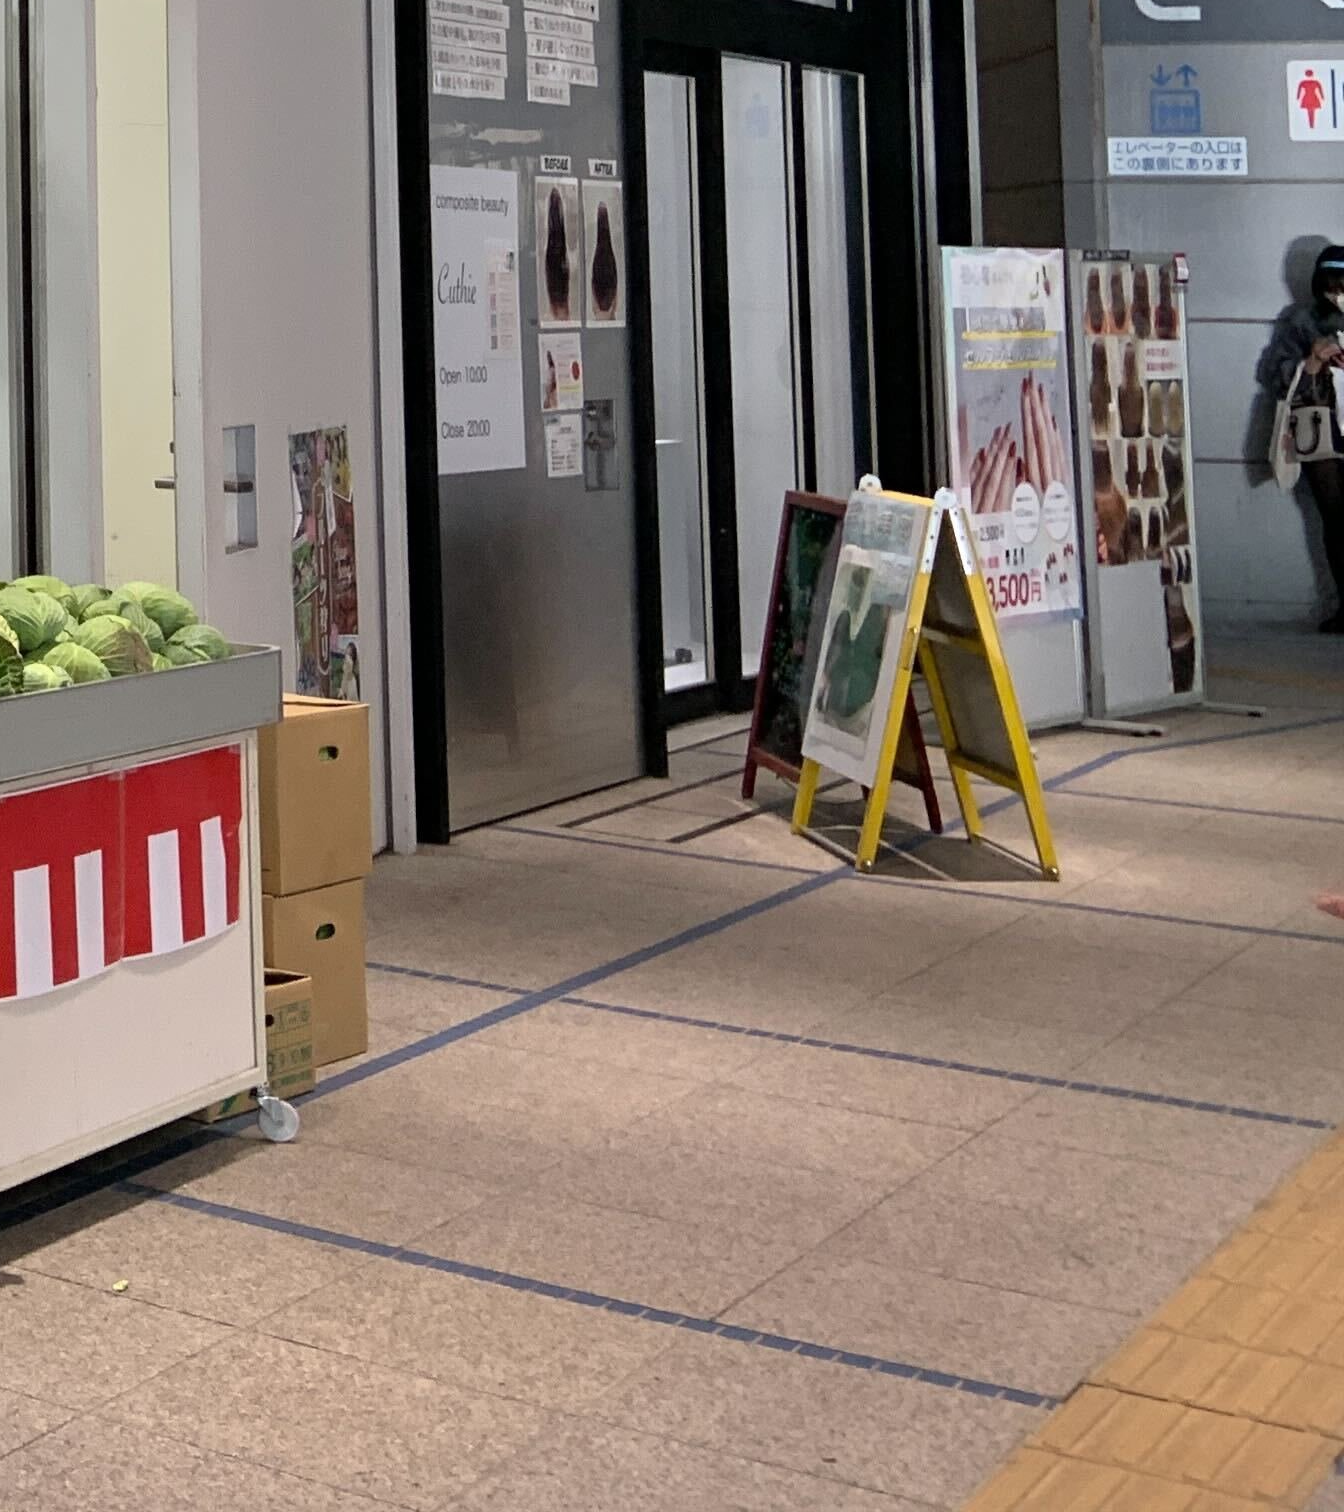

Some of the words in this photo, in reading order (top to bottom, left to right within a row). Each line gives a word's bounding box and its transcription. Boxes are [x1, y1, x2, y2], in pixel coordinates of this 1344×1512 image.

[1113, 141, 1243, 154] エレベーターの入口は
[1113, 157, 1244, 171] この裏側にあります
[436, 195, 479, 214] composite
[480, 195, 509, 217] beauty
[437, 261, 478, 306] Cuthie
[439, 366, 462, 386] Open
[440, 421, 465, 440] Close
